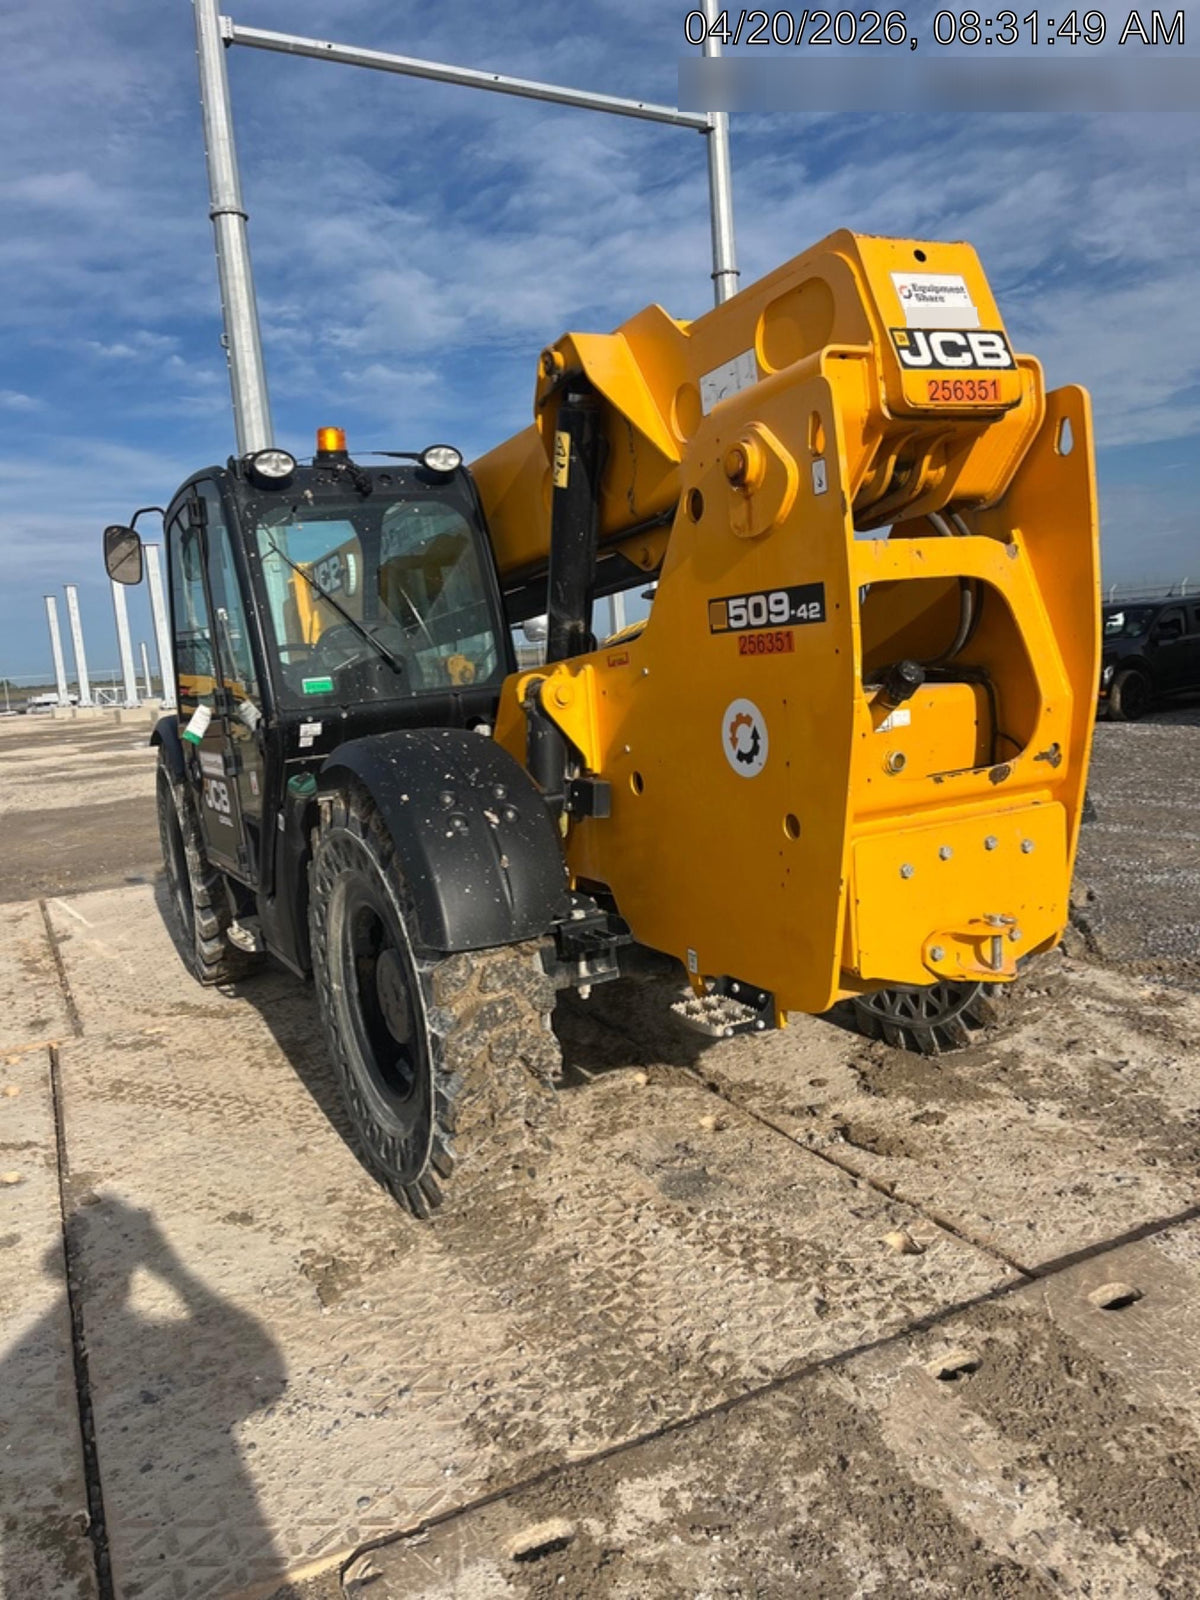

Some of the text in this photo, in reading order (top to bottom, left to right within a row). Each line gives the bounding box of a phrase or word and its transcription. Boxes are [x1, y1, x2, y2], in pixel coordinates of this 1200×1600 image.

[899, 331, 1012, 367] JCB
[928, 379, 1000, 402] 256351
[739, 631, 794, 655] 256351
